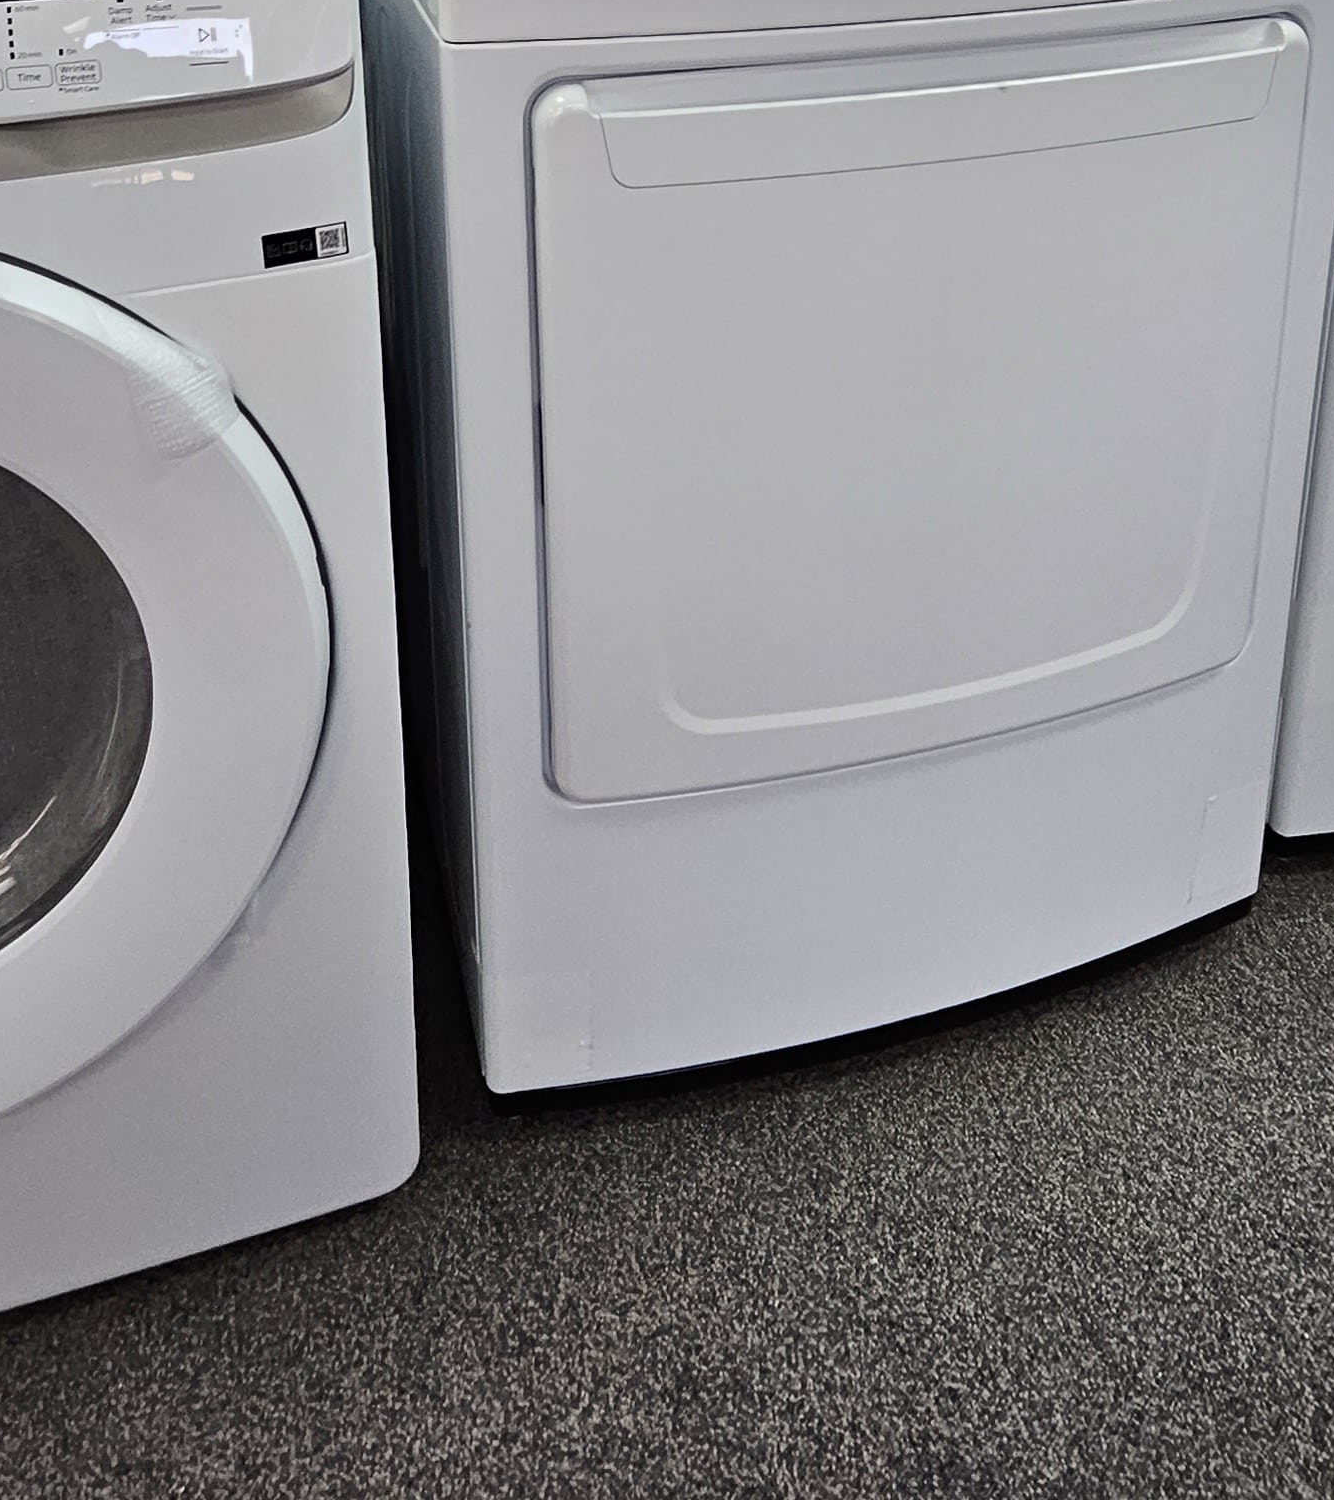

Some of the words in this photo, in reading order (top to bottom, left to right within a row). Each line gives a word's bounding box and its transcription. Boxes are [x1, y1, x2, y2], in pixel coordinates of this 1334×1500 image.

[108, 7, 134, 15] Damp
[145, 3, 172, 13] Adjust
[111, 16, 133, 26] Alert
[146, 14, 166, 22] Time
[17, 73, 42, 82] Time
